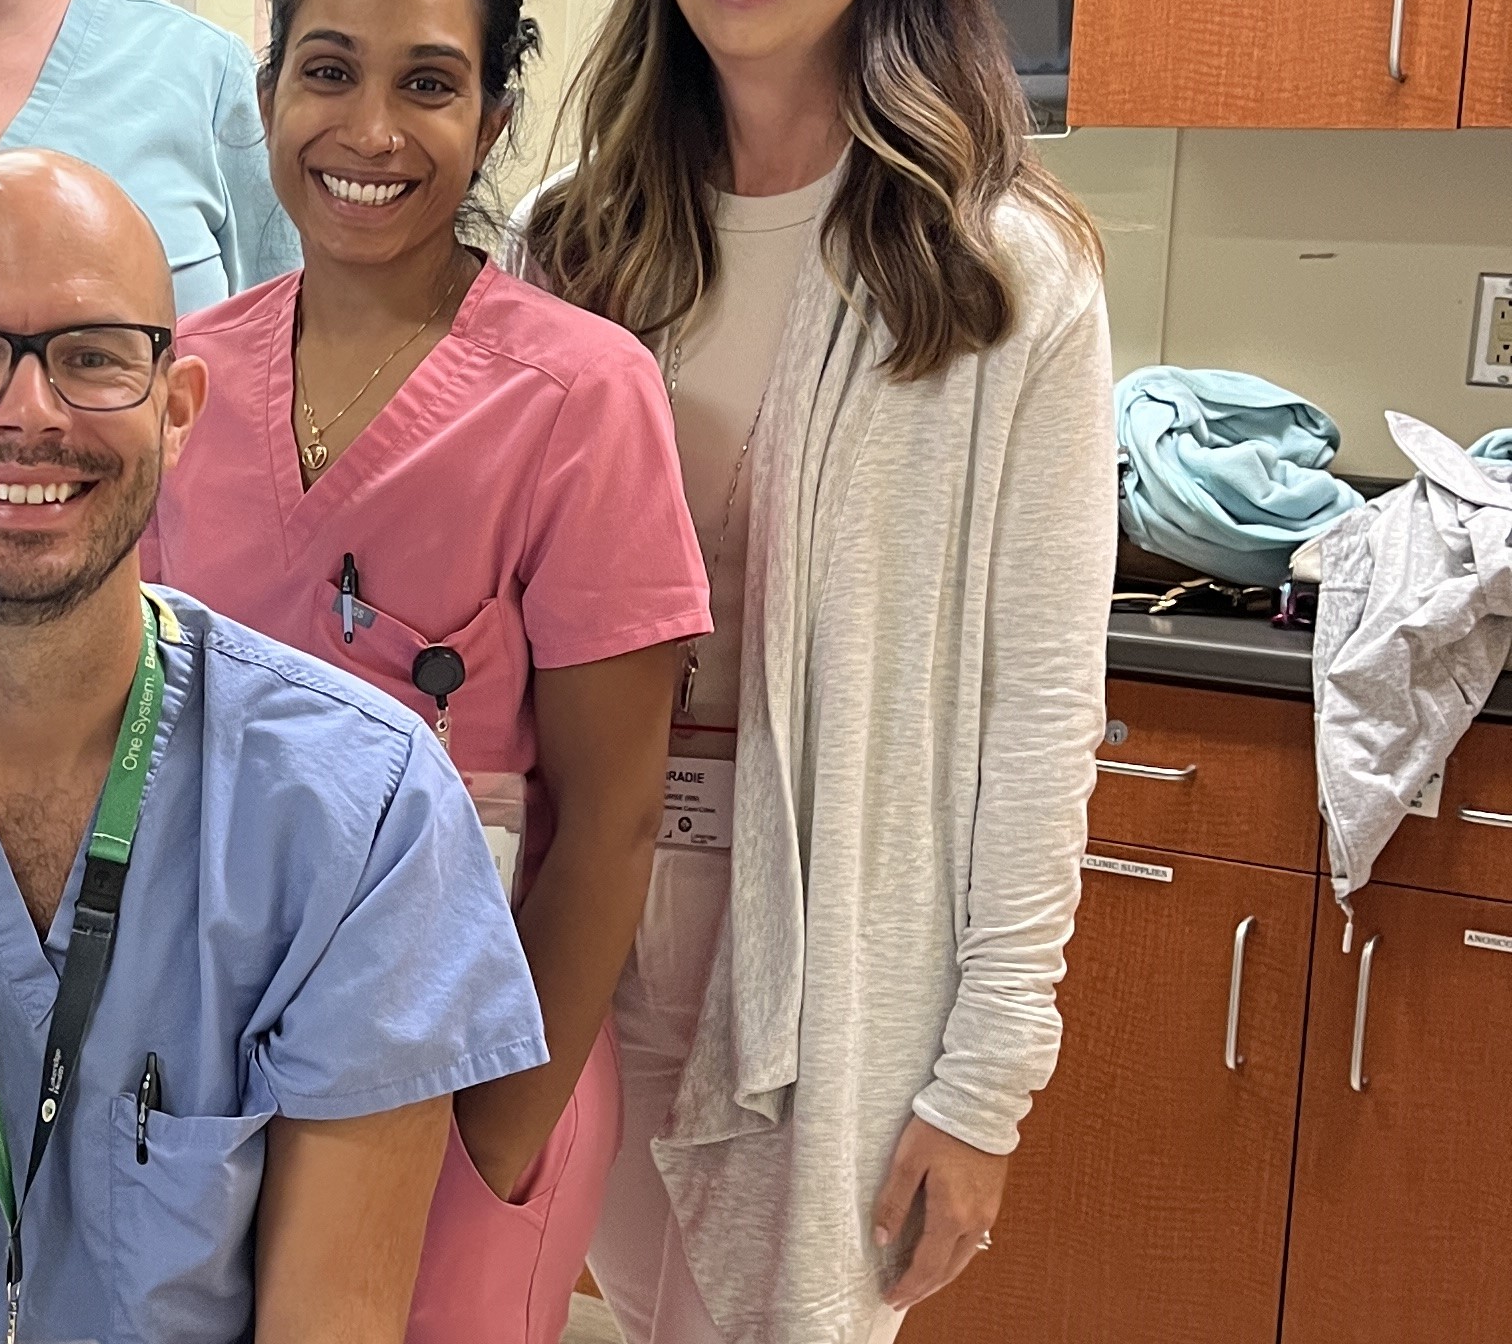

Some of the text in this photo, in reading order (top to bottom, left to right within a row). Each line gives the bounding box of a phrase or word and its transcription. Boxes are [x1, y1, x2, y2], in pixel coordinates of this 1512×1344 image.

[145, 633, 156, 669] Best
[131, 674, 156, 735] System.
[122, 737, 143, 771] One
[1086, 857, 1120, 870] CLINIC
[1120, 863, 1168, 878] SUPPLIES
